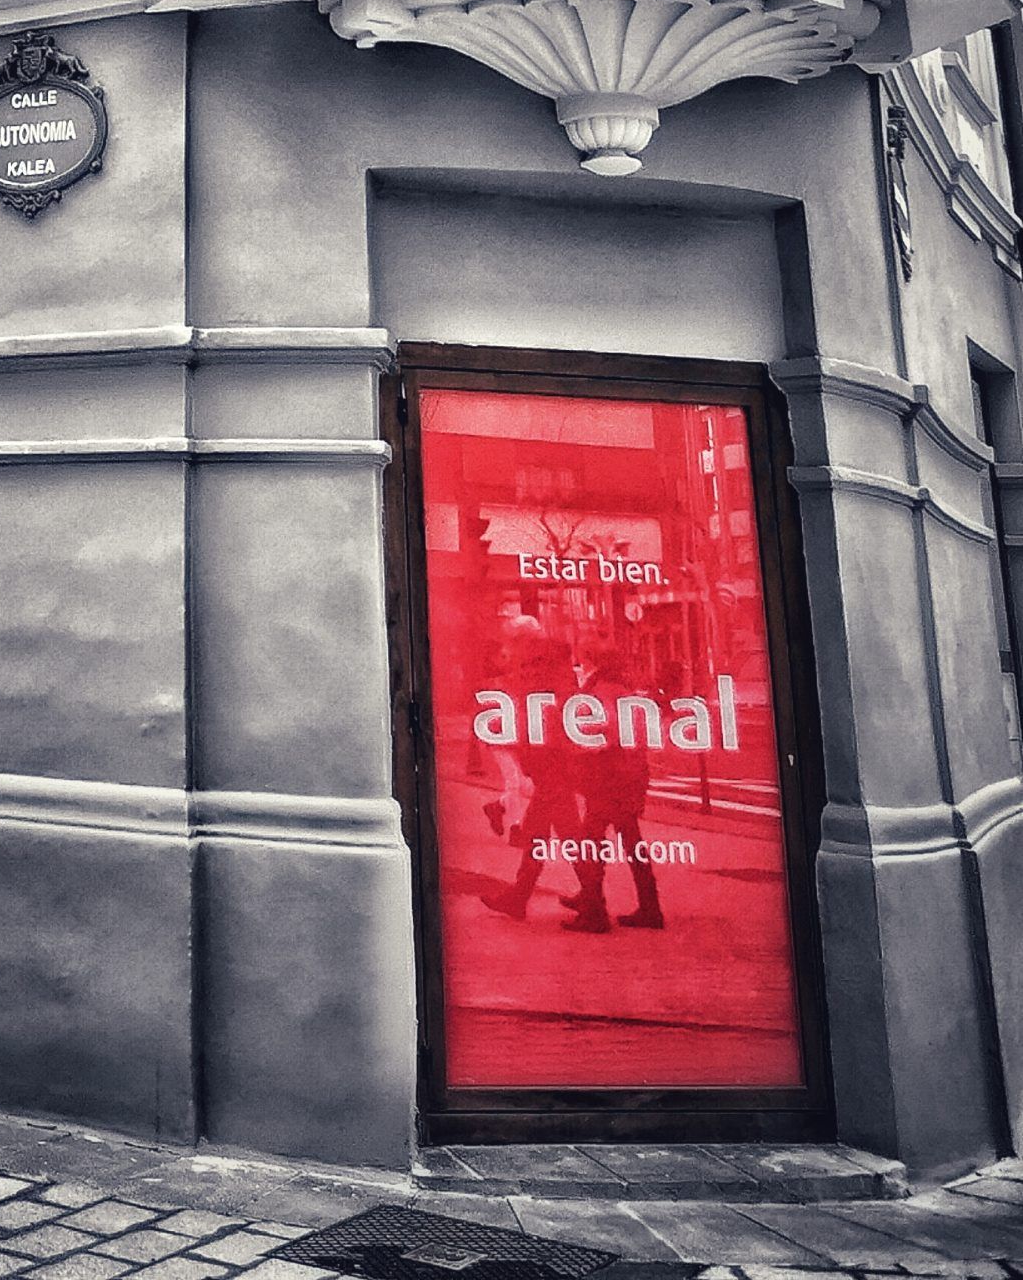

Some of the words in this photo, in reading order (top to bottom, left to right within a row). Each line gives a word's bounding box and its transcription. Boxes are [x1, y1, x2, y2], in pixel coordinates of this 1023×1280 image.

[11, 90, 58, 108] CALLE
[7, 158, 56, 177] KALEA
[518, 552, 590, 581] Estar
[598, 553, 670, 585] bien.
[473, 674, 739, 751] arenal
[531, 831, 696, 865] arenal.com
